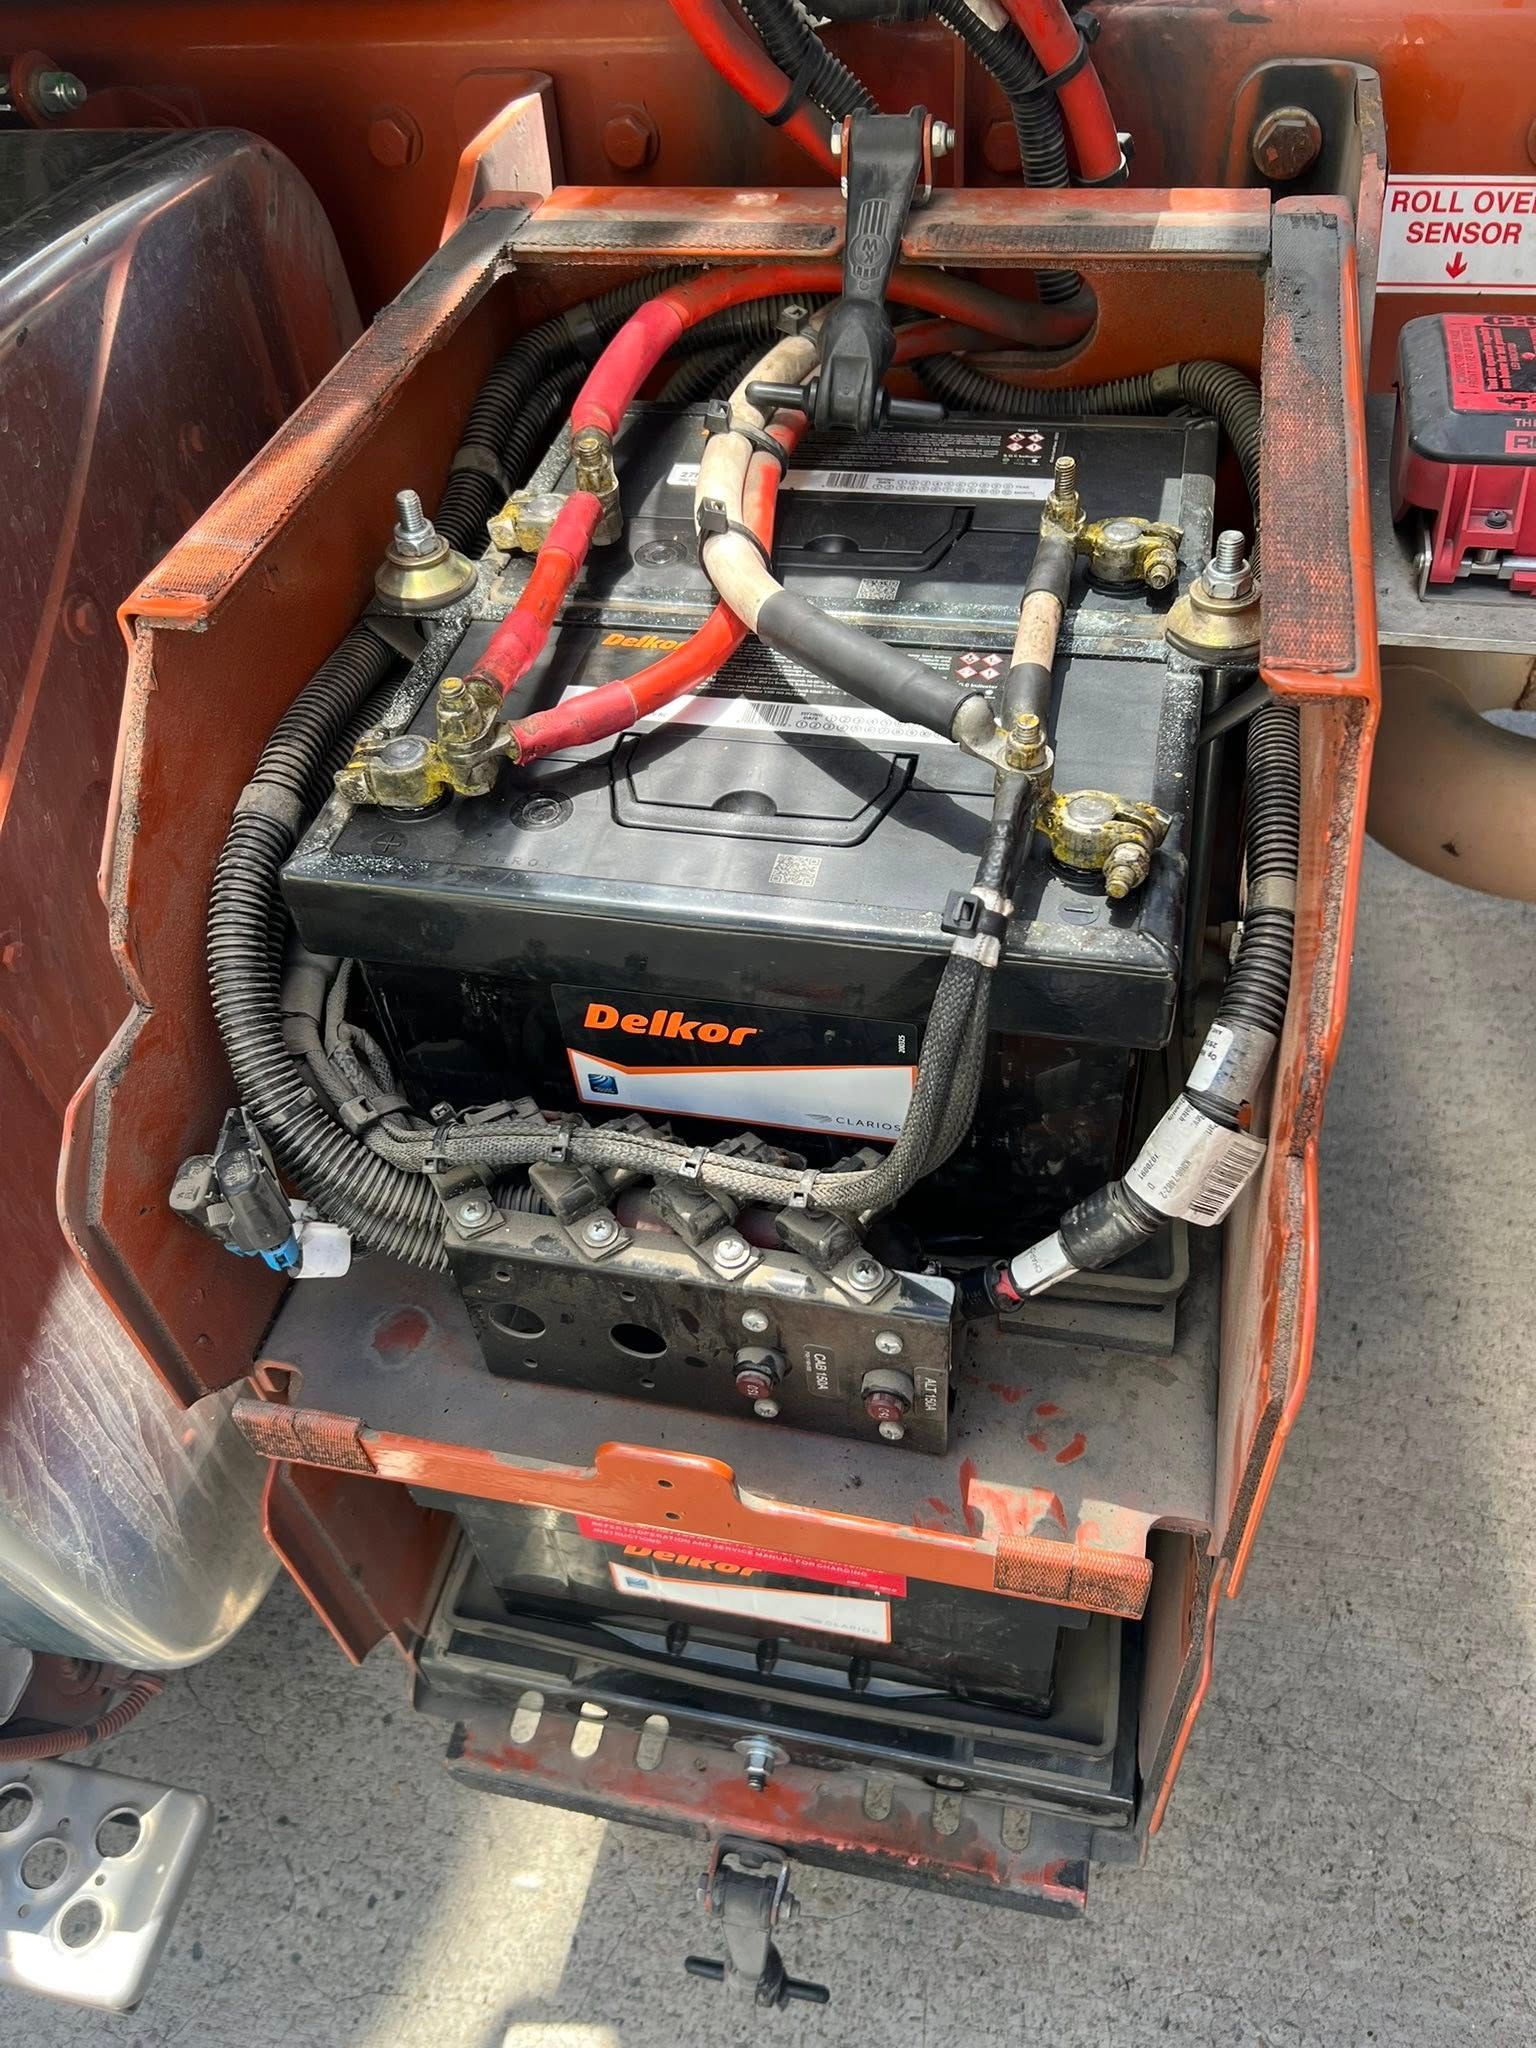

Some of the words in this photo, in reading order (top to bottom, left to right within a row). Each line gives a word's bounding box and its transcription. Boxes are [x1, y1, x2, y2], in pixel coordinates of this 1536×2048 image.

[1391, 190, 1464, 213] ROLL
[1474, 190, 1536, 214] OVE
[1406, 221, 1522, 244] SENSOR
[583, 1003, 758, 1046] Delkor
[836, 1116, 901, 1132] CLARIOS
[813, 1353, 827, 1370] CAB
[924, 1377, 937, 1395] ALT
[692, 1539, 712, 1548] AND
[713, 1543, 754, 1556] SERVICE
[755, 1551, 793, 1563] MANUAL
